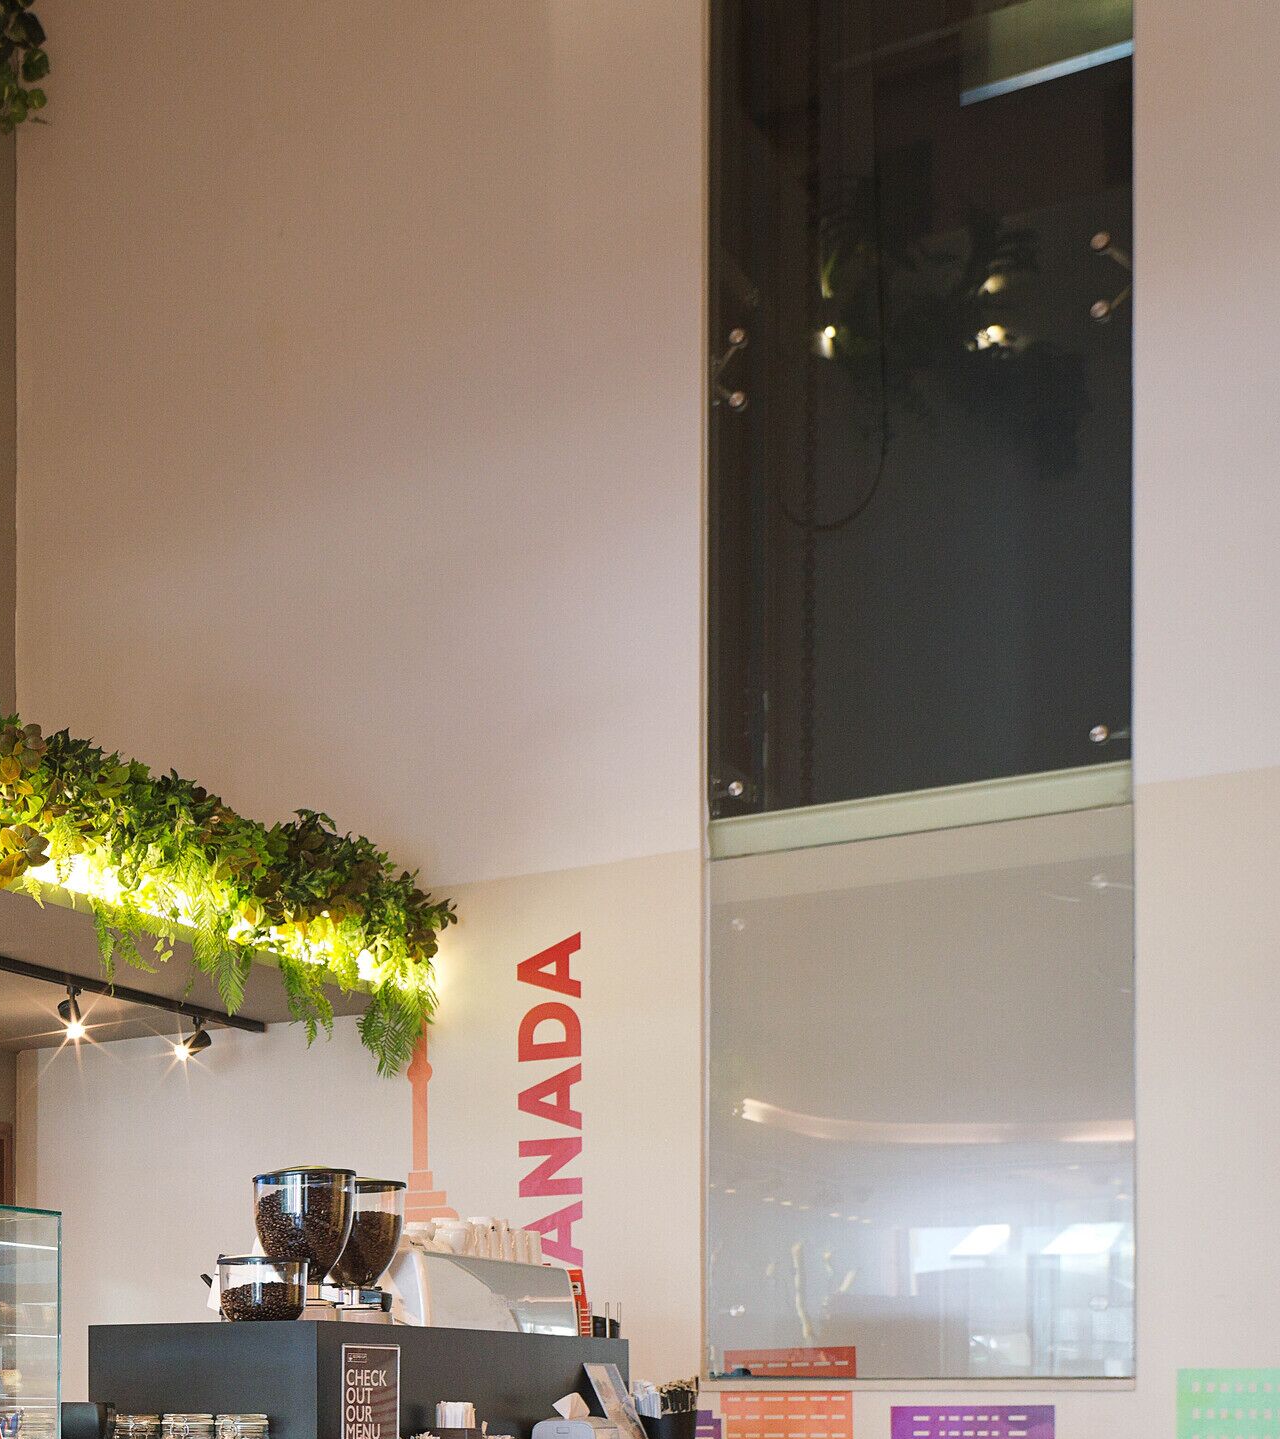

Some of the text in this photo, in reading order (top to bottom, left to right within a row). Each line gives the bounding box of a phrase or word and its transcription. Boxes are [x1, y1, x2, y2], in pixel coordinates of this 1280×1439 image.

[516, 931, 583, 1268] ANADA
[346, 1369, 387, 1387] CHECK
[346, 1387, 373, 1404] OUT
[346, 1405, 372, 1423] OUR
